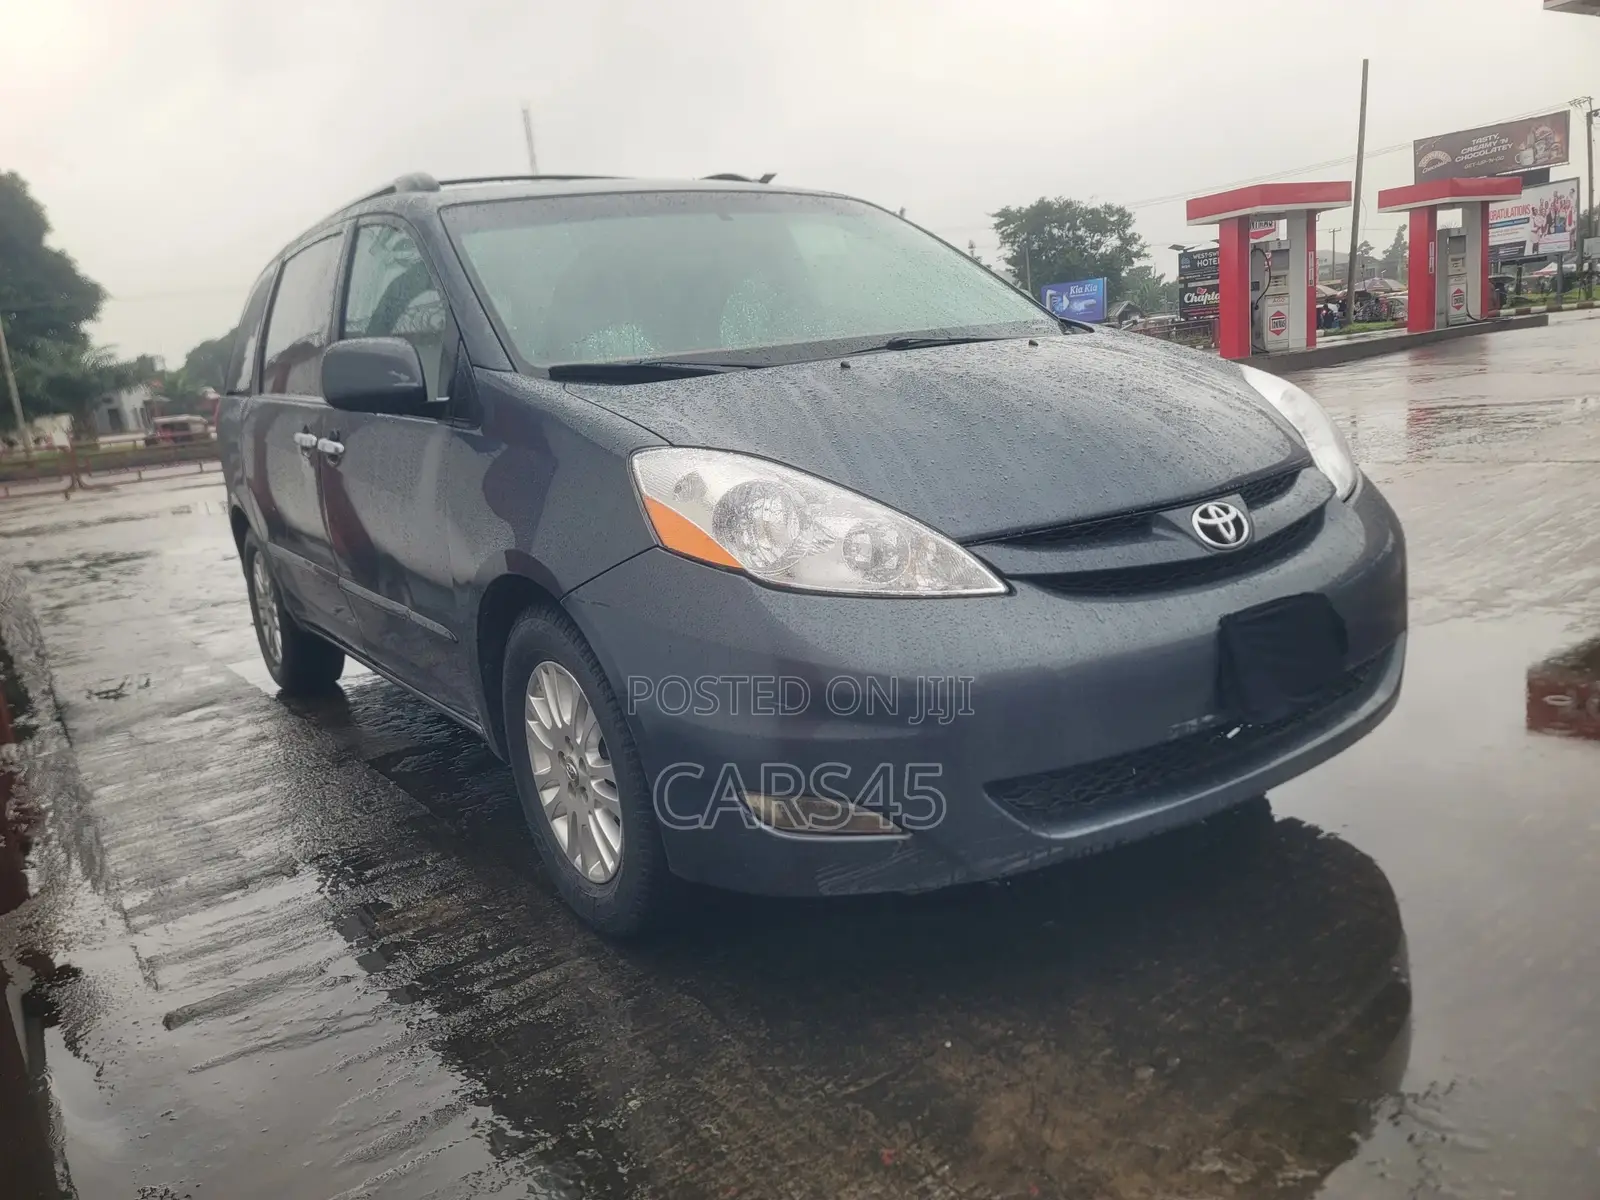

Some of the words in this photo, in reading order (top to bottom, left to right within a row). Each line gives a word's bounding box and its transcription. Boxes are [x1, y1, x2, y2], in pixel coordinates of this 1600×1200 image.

[1472, 133, 1500, 145] TASTY,
[1454, 142, 1514, 162] CHOCOLATEY
[1461, 140, 1498, 155] CREAMY
[1489, 203, 1531, 221] GRATULATIONS
[1070, 285, 1083, 295] Kia
[1084, 283, 1098, 293] Kia
